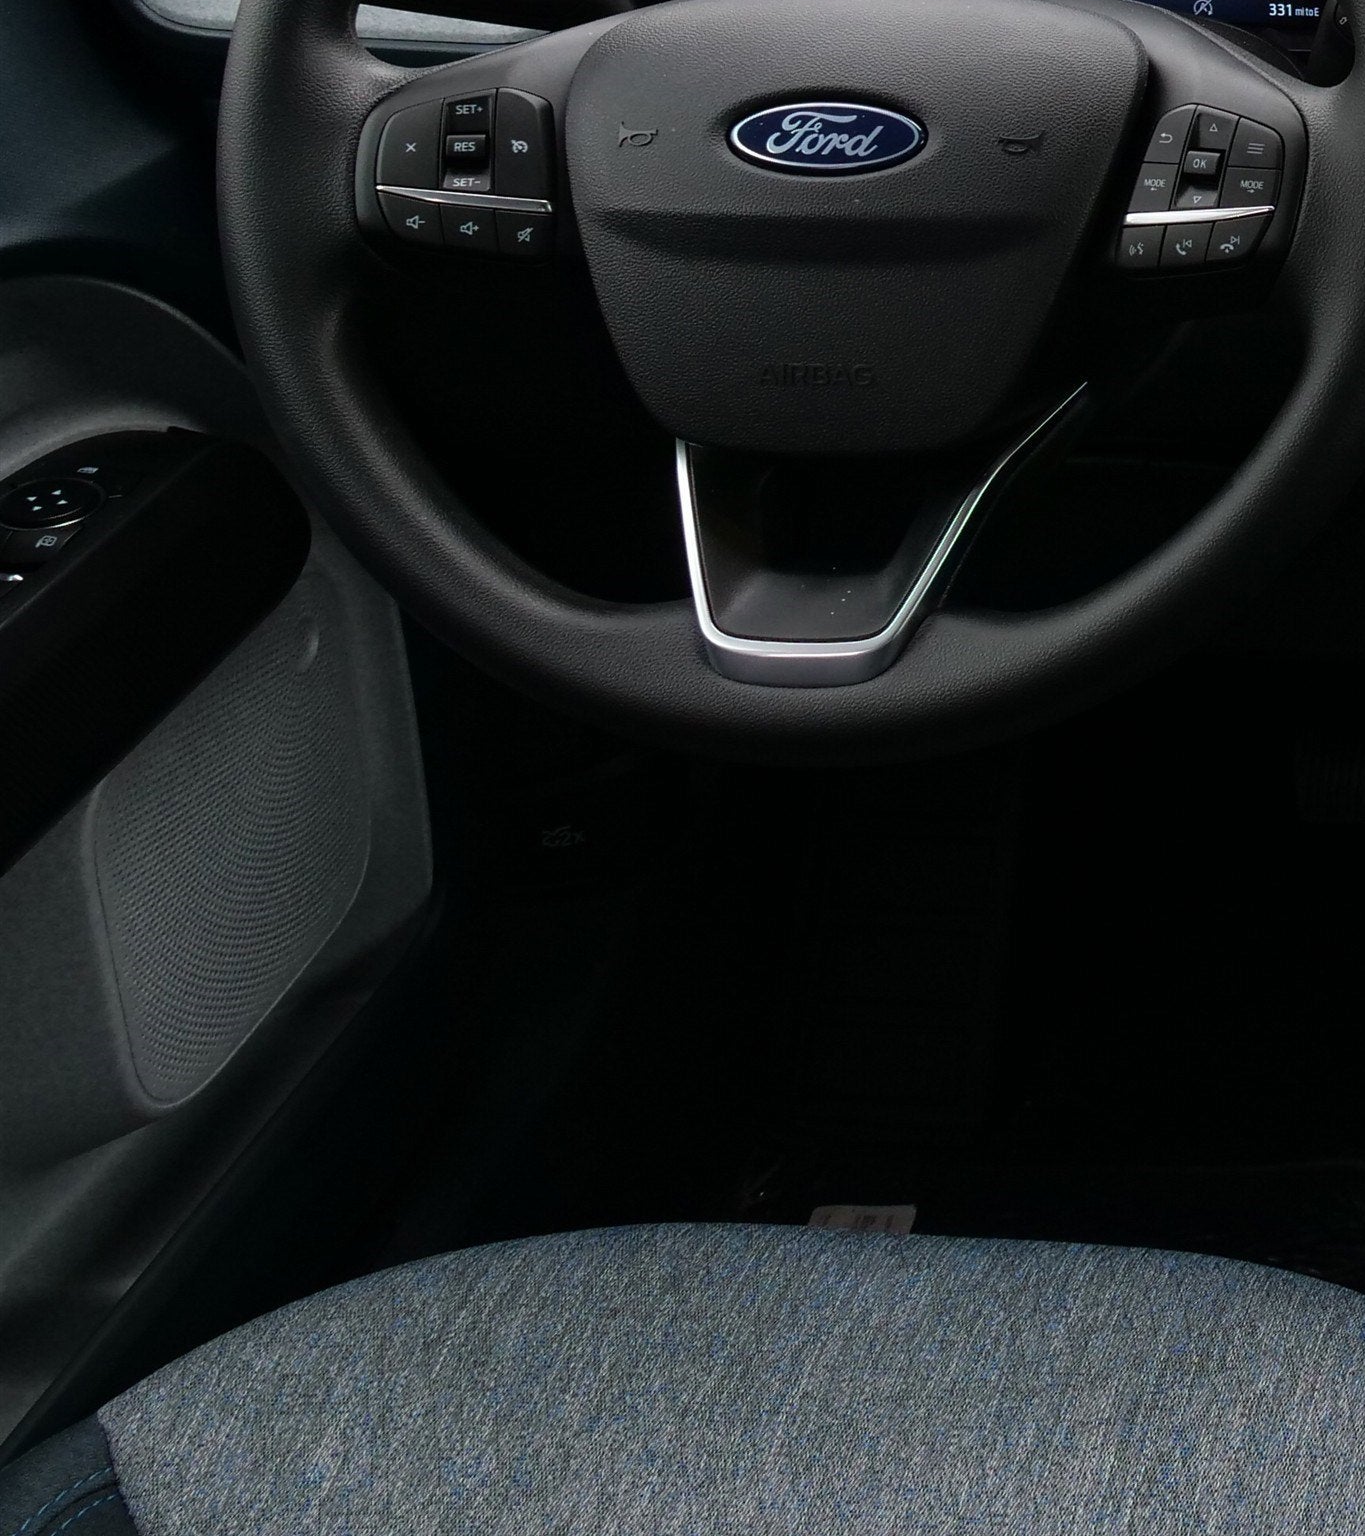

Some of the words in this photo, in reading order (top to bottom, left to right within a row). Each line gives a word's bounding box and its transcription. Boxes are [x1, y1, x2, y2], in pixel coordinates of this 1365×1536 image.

[1269, 3, 1292, 17] 331
[455, 104, 484, 115] SET+
[766, 111, 884, 157] Ford
[454, 142, 475, 152] RES
[1192, 159, 1208, 169] OK
[1144, 179, 1166, 188] MODE
[1240, 180, 1264, 189] MODE
